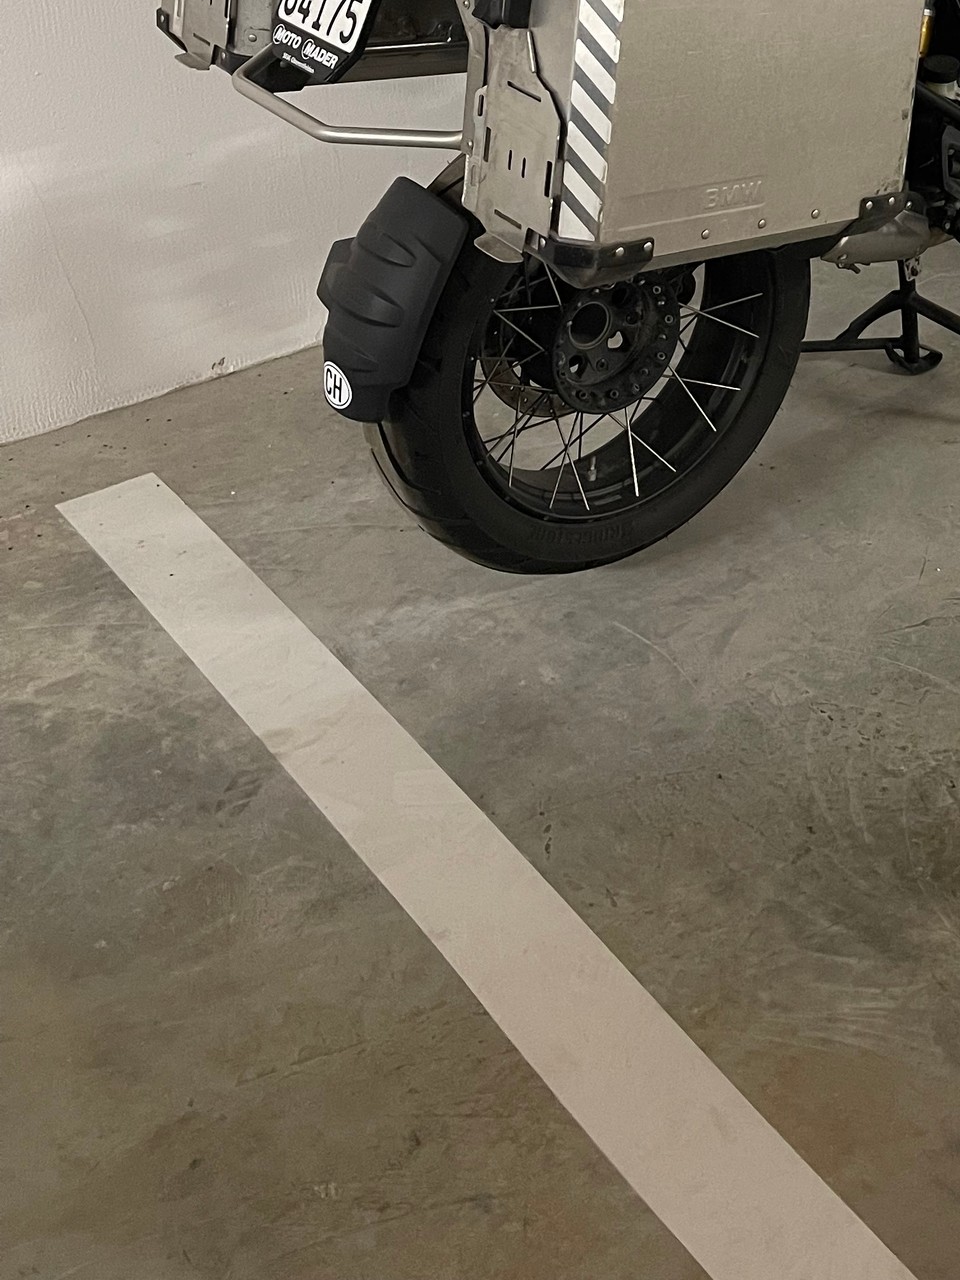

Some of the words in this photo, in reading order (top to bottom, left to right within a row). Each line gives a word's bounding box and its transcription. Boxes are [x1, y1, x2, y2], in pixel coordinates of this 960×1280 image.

[273, 24, 302, 49] MOTO
[302, 39, 339, 69] MADER
[703, 180, 762, 210] BMW
[326, 368, 342, 403] CH
